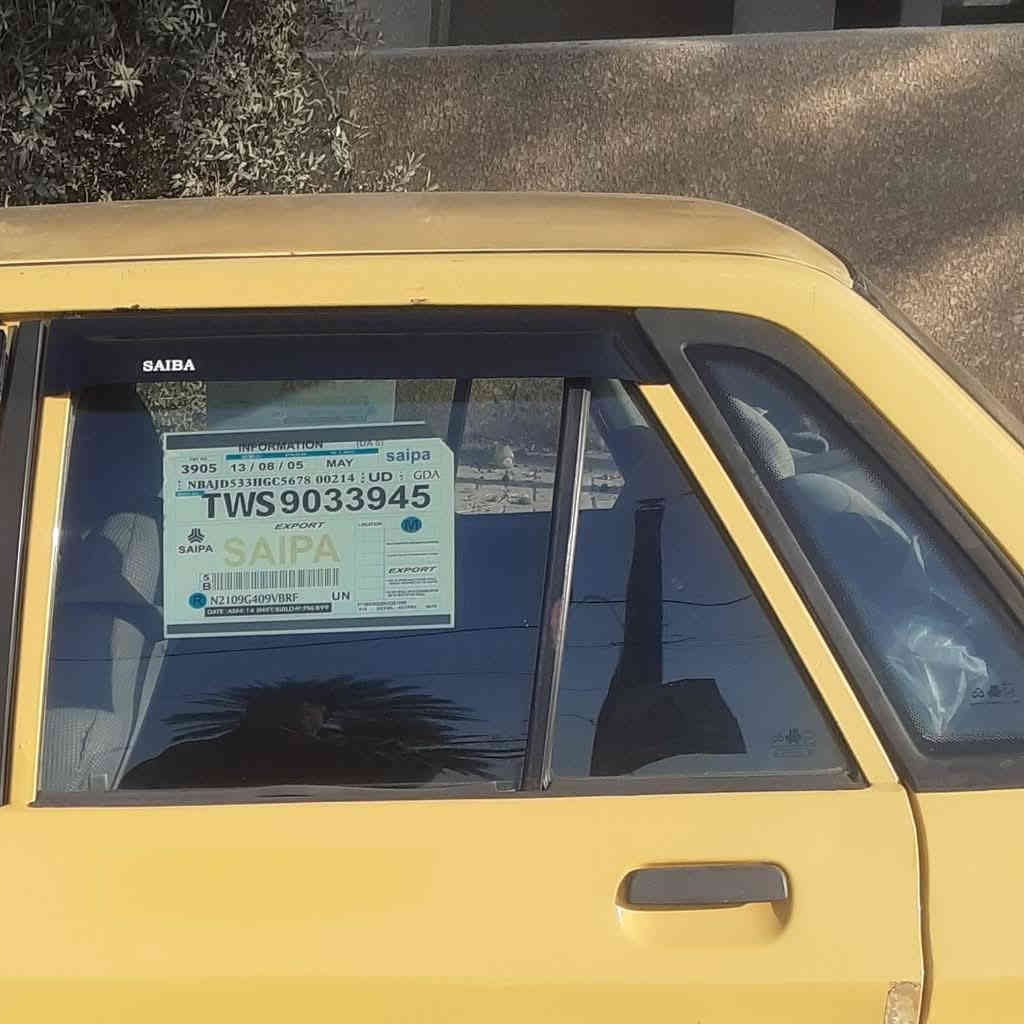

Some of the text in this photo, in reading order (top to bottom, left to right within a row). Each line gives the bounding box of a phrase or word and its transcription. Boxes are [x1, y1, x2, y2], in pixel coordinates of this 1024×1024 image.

[142, 359, 195, 373] SAIBA
[237, 440, 324, 453] INFORMATION
[385, 448, 432, 464] saipa
[181, 463, 217, 475] 3905
[326, 458, 354, 468] MAY
[315, 473, 355, 485] 00214
[368, 471, 393, 482] UD
[274, 520, 326, 531] EXPORT
[178, 543, 214, 554] SAIPA
[223, 533, 342, 568] SAIPA
[388, 565, 438, 575] EXPORT
[332, 591, 351, 601] UN
